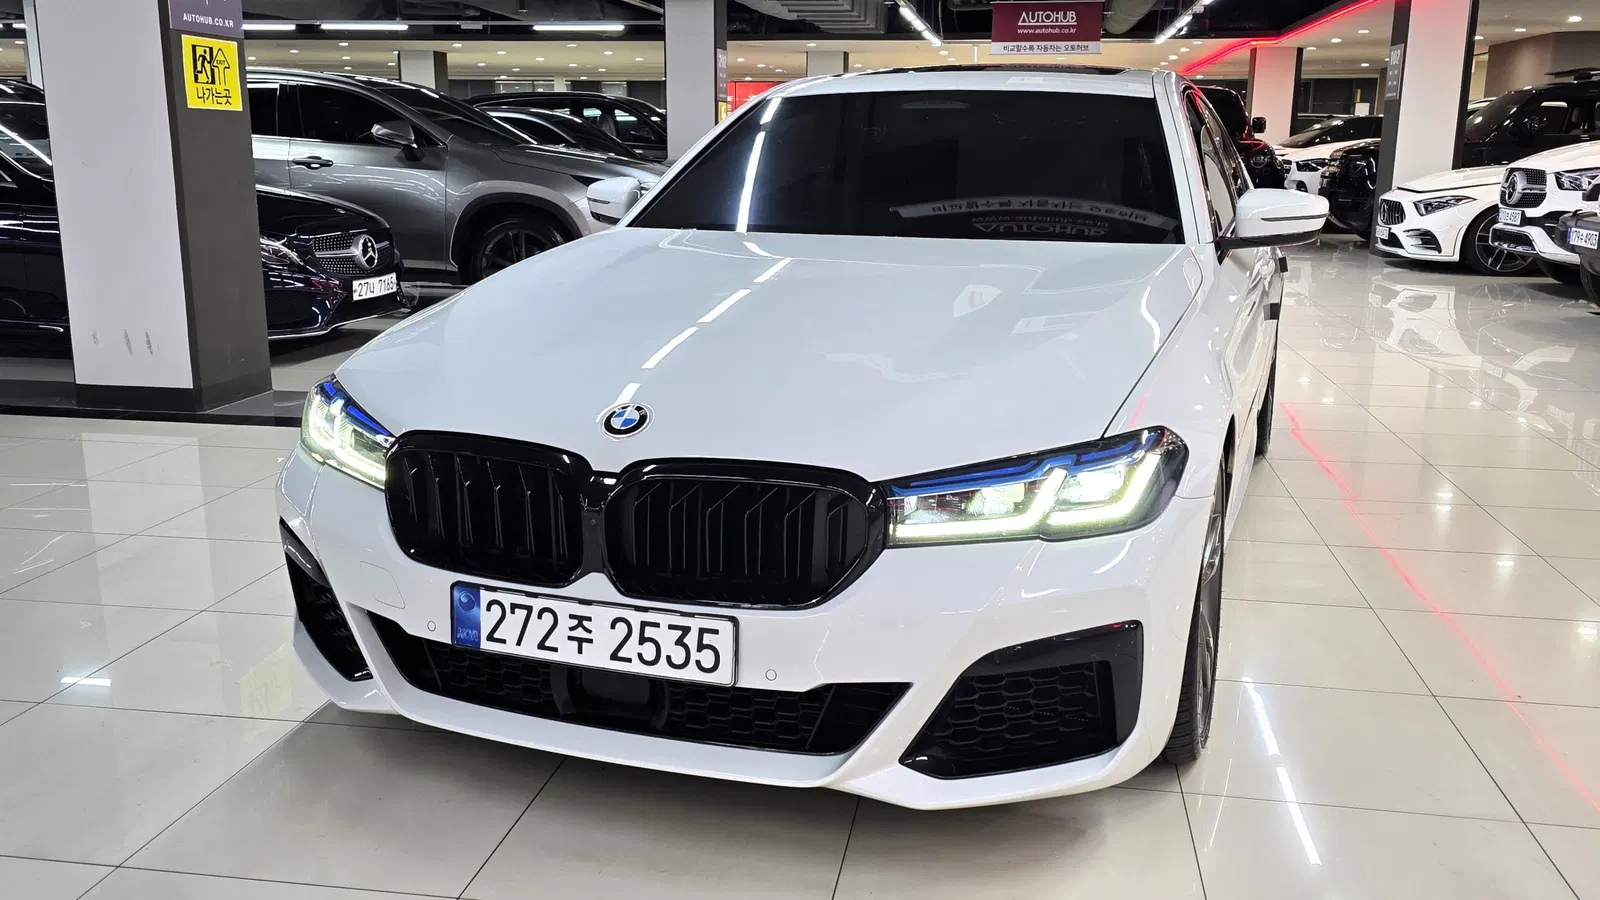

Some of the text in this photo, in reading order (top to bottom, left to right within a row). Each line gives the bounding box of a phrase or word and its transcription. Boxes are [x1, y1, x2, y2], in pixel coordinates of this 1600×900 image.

[183, 13, 234, 28] AUTOHUB.CO.KR
[1018, 11, 1077, 25] AUTOHUB
[1003, 44, 1089, 52] 비교할수록 자동차는 오토허브
[196, 86, 232, 106] 나가는곳
[378, 276, 395, 293] 7165
[457, 627, 480, 641] KOR
[609, 616, 721, 674] 2535
